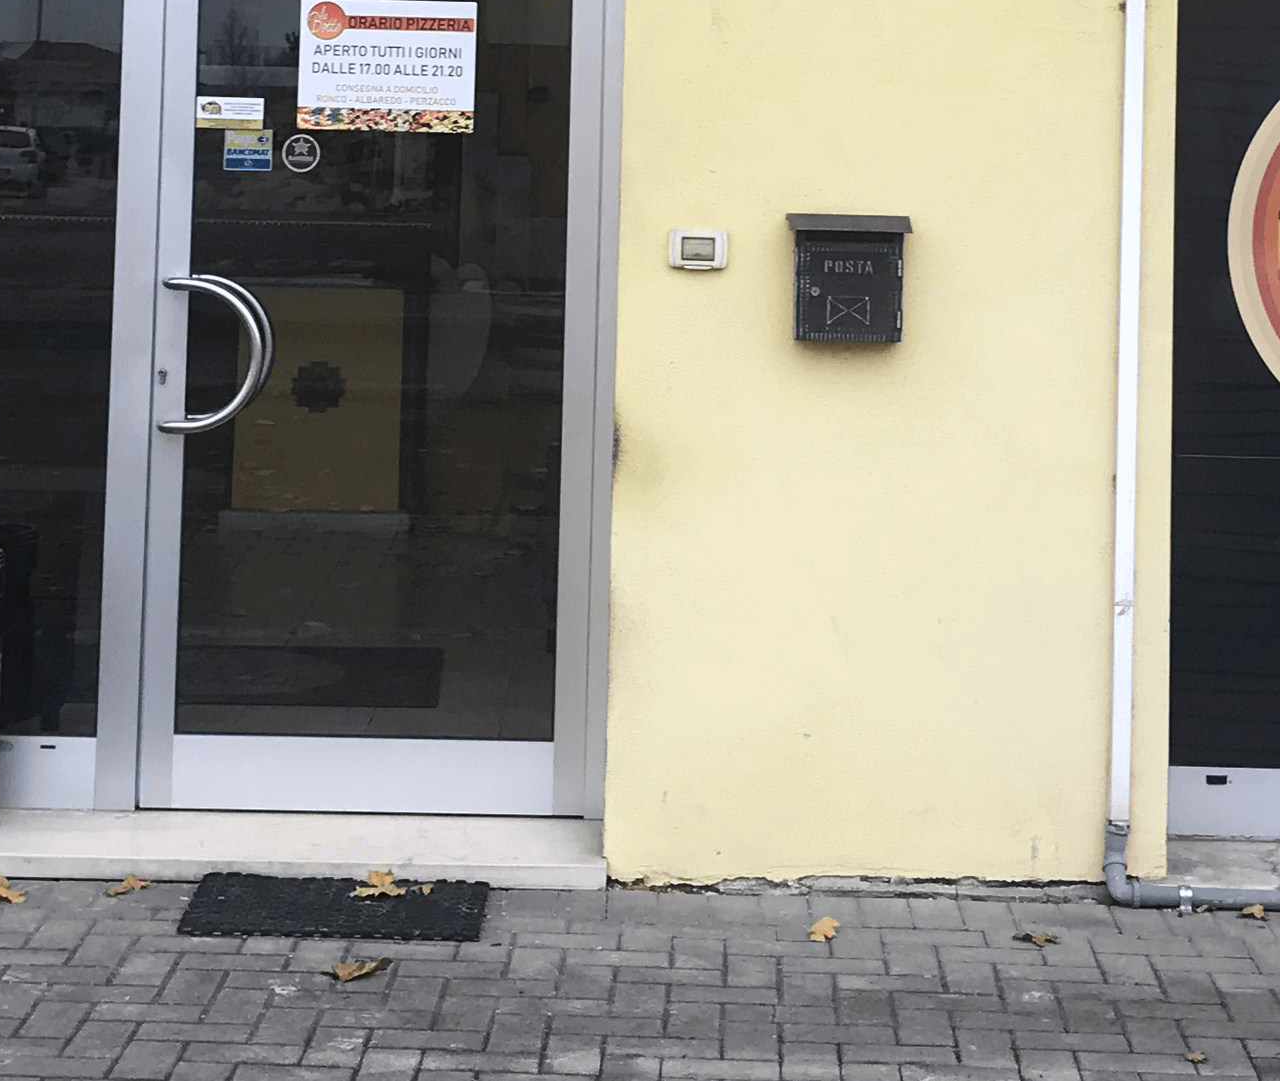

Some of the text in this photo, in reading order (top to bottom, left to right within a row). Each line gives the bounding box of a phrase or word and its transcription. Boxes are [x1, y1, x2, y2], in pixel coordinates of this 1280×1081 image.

[347, 15, 402, 30] ORARIO
[406, 17, 470, 32] PIZZERIA
[314, 44, 462, 59] APERTO TUTTI I GIORNI
[312, 61, 463, 77] DALLE 17.00 ALLE 21.20
[335, 84, 383, 93] CONSEGNA
[824, 259, 874, 275] POSTA
